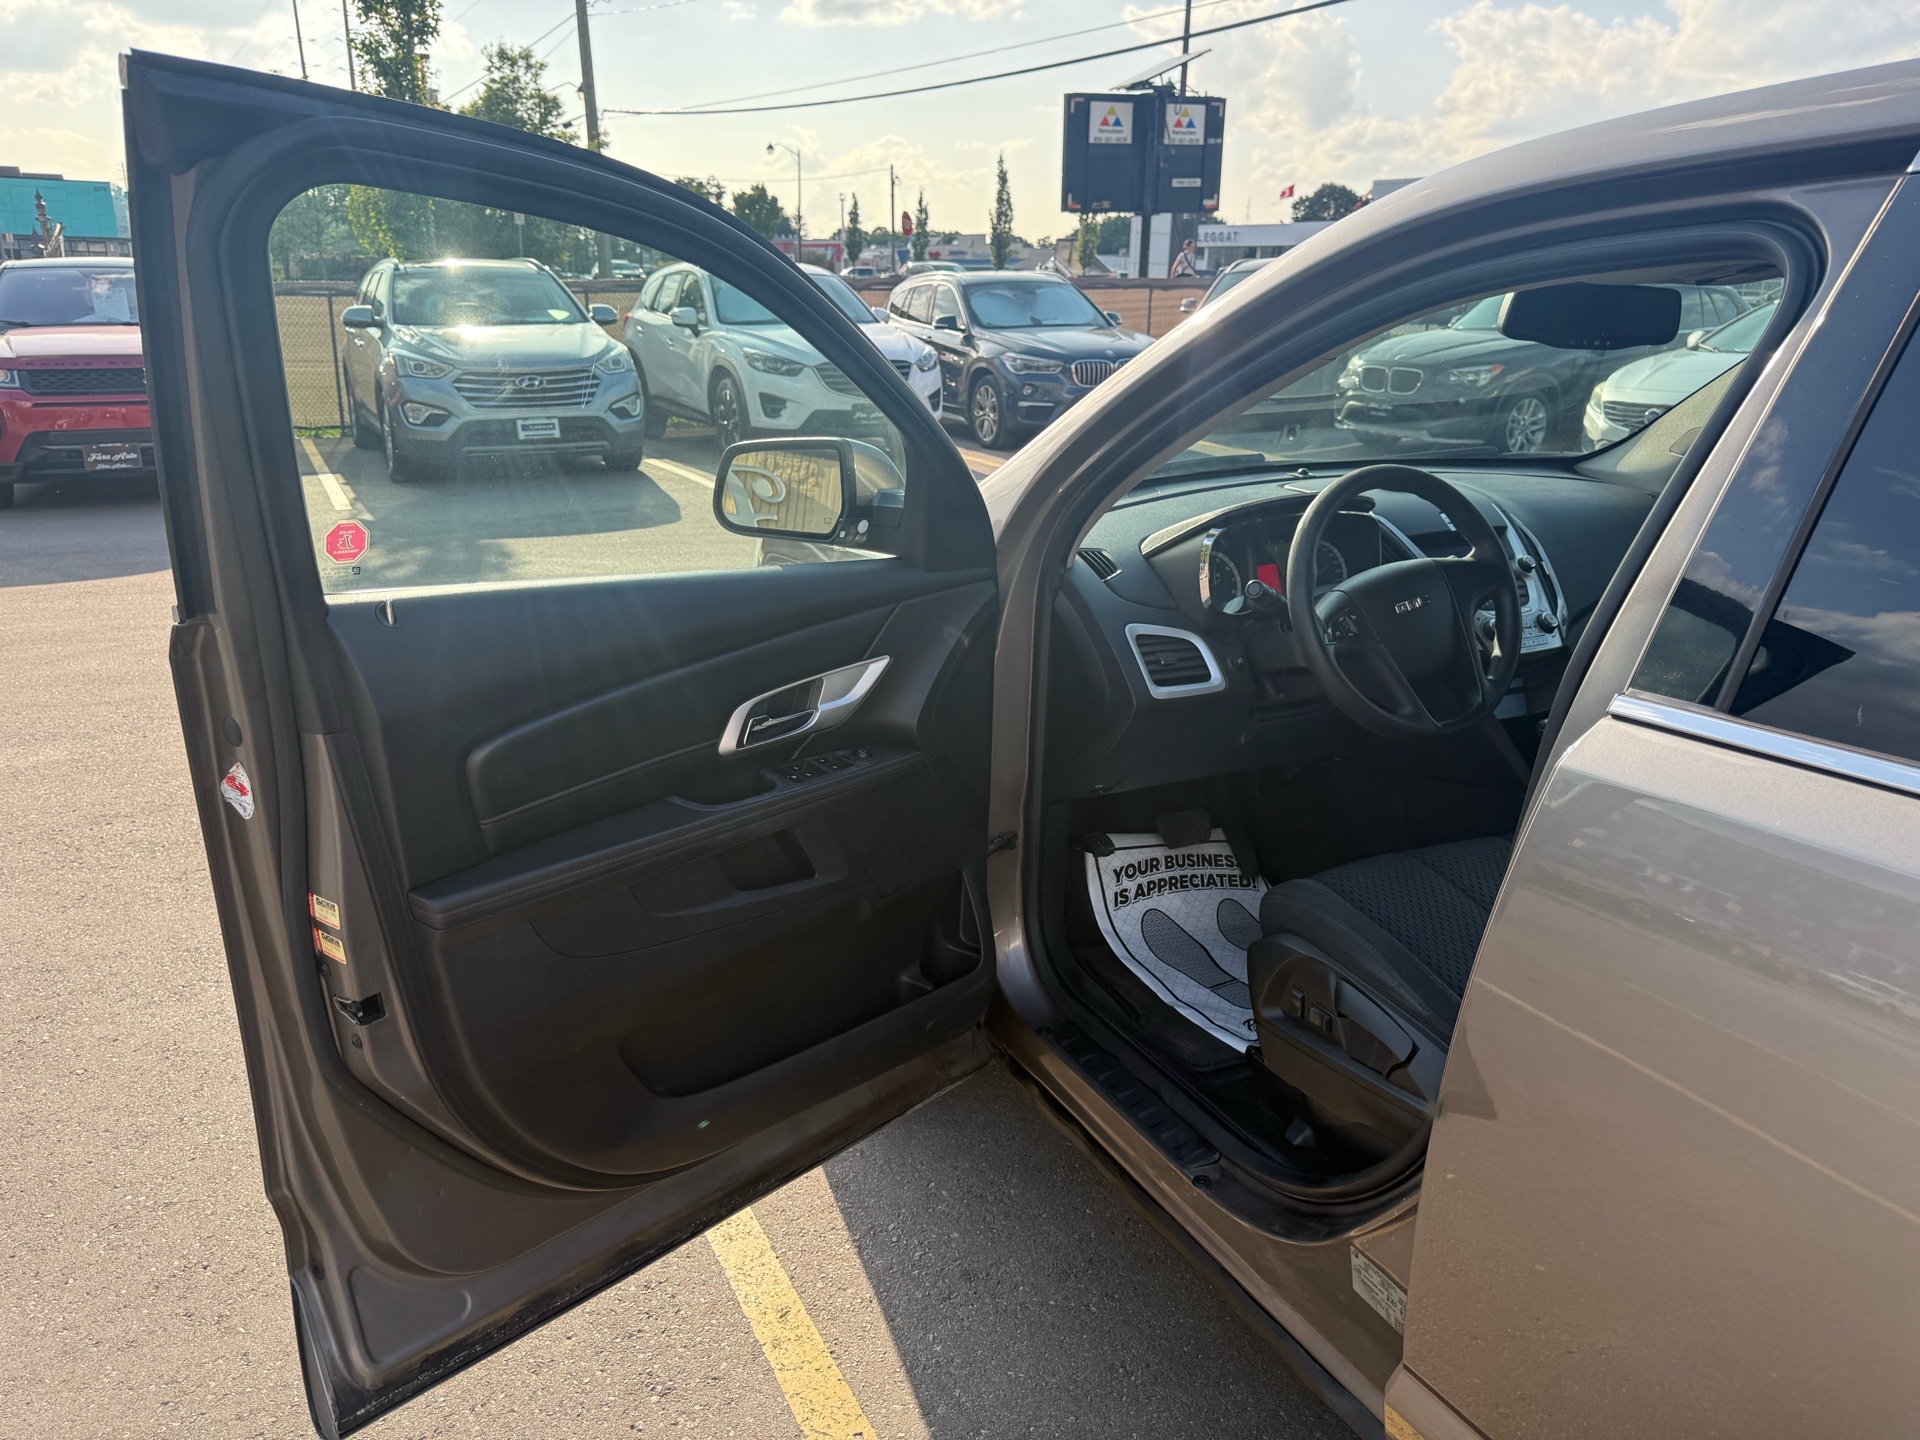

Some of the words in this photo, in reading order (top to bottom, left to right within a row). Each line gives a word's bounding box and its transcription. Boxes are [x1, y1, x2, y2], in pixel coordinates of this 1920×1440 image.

[1198, 231, 1240, 242] LEGGAT
[112, 452, 138, 462] Auto
[1395, 594, 1430, 614] GMC
[1113, 857, 1160, 884] YOUR
[1164, 853, 1241, 870] BUSINES
[1114, 890, 1129, 910] IS
[1132, 874, 1258, 902] APPRECIATED!
